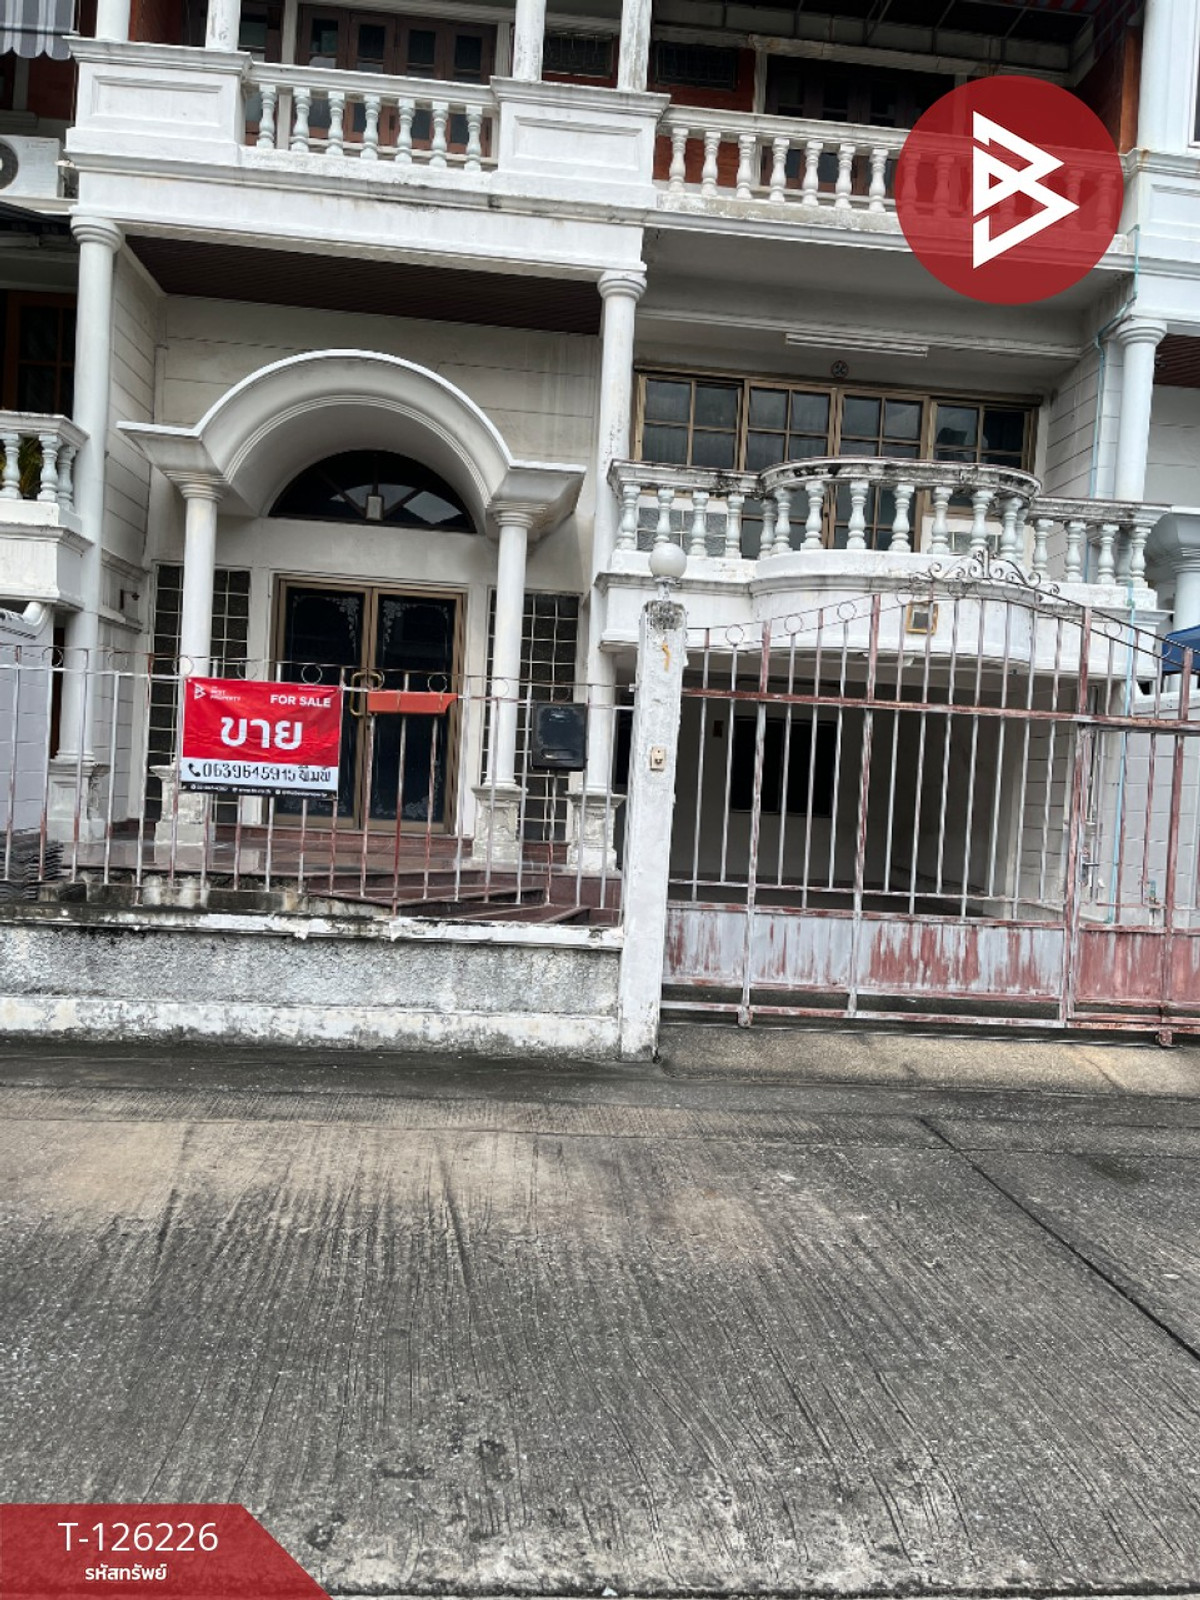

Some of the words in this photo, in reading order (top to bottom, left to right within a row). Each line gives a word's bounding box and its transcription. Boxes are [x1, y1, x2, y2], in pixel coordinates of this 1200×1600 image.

[270, 694, 296, 705] FOR
[299, 697, 331, 708] SALE
[221, 716, 303, 750] ขาย
